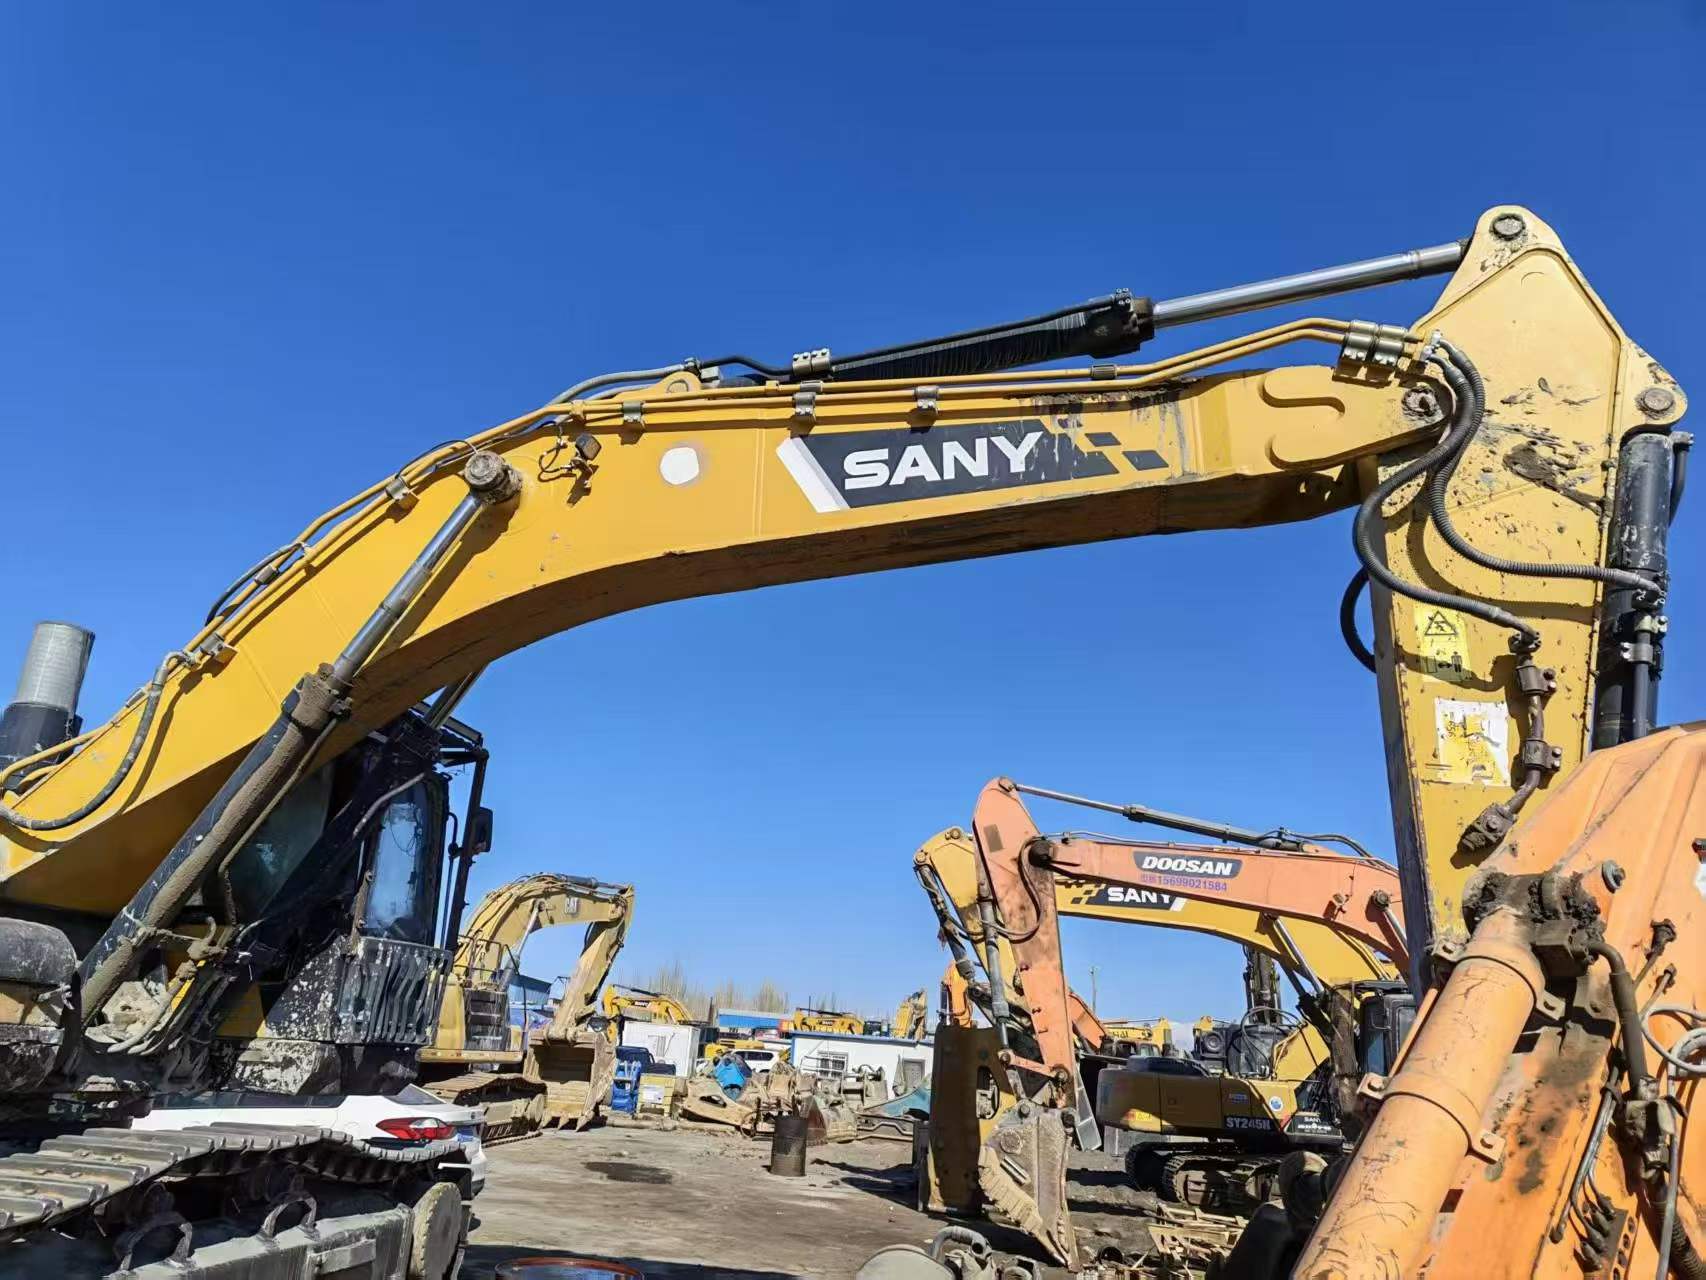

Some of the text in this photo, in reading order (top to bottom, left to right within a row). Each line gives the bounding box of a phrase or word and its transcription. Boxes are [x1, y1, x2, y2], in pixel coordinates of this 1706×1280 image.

[843, 431, 1044, 490] SANY
[1142, 856, 1233, 876] DOOSAN
[1107, 886, 1171, 904] SANY
